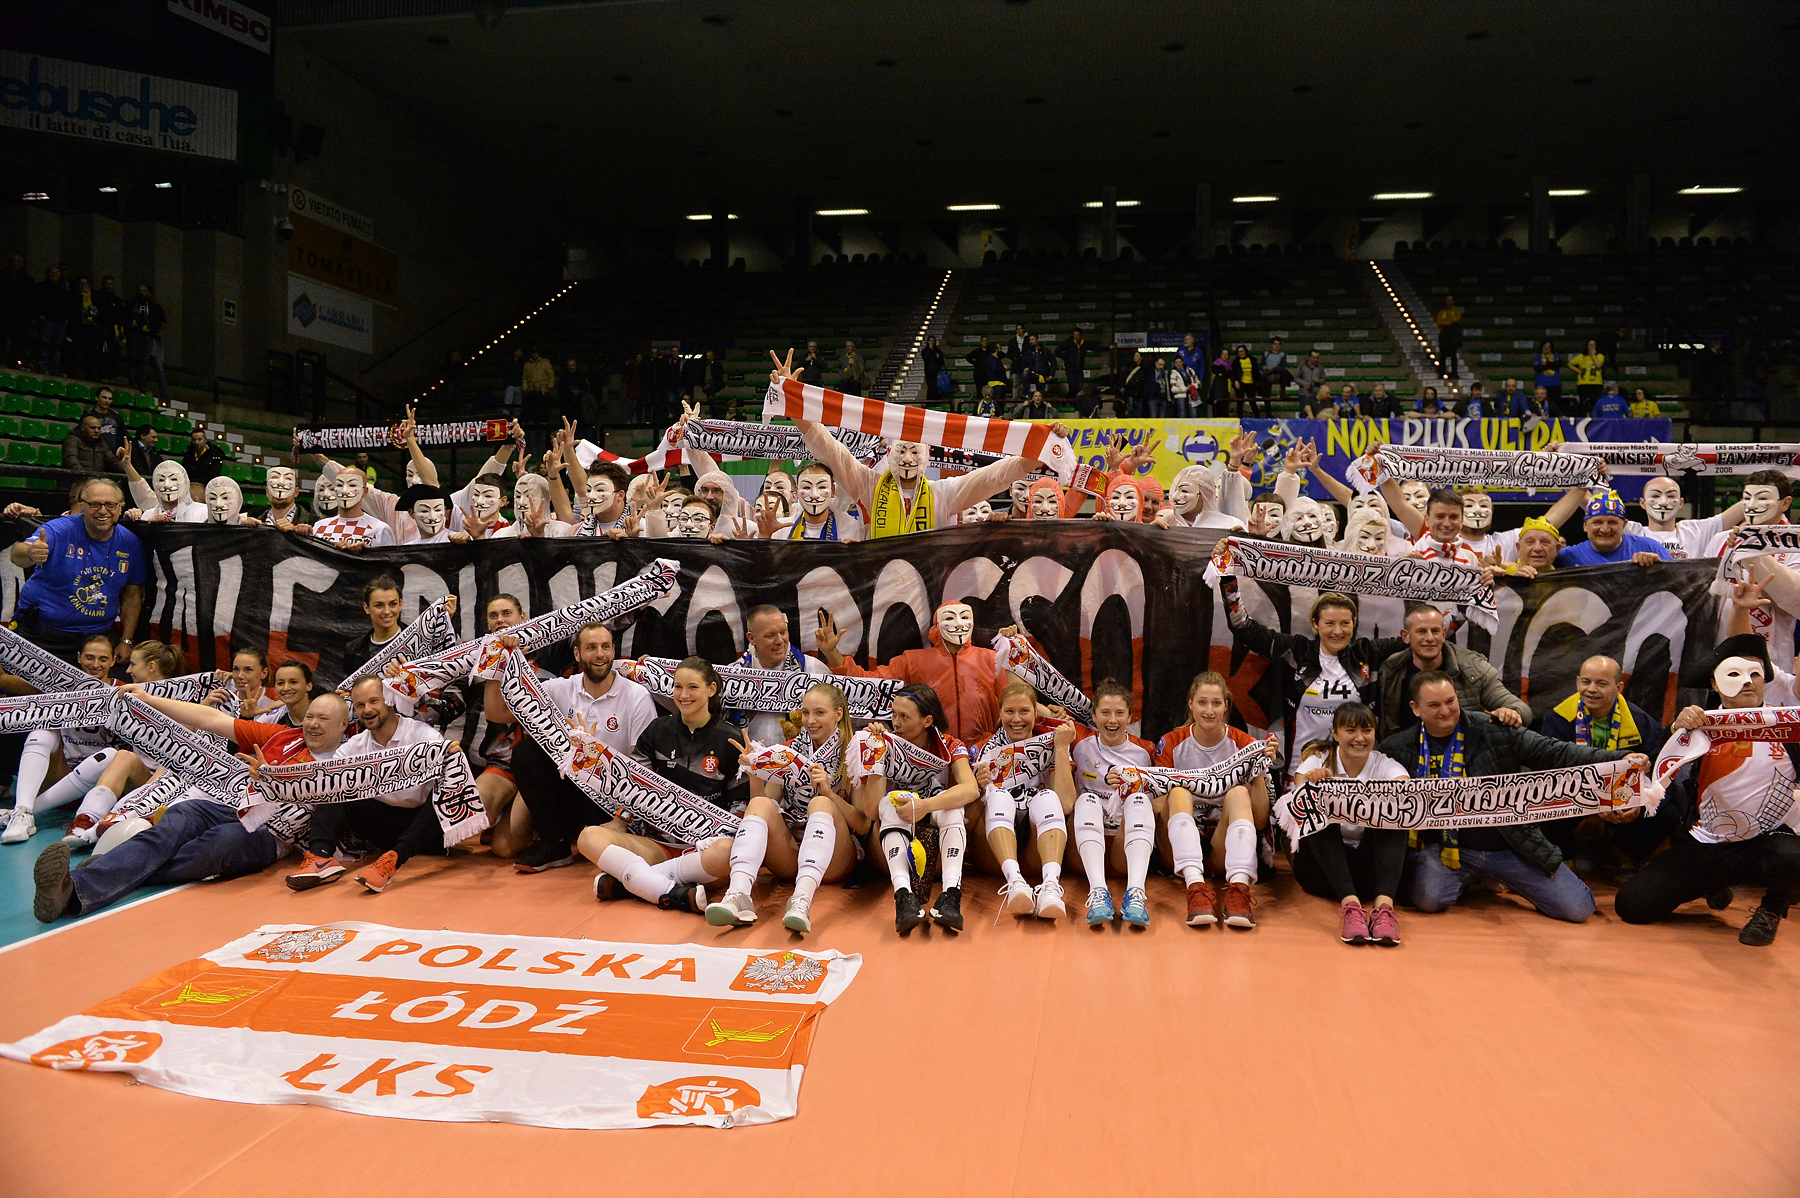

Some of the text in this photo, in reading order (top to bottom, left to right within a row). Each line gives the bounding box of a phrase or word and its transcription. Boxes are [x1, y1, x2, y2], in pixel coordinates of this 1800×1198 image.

[29, 114, 196, 153] il latte di casa Tua.
[308, 198, 341, 222] VIETATO
[296, 247, 393, 296] TOMASELLA
[320, 421, 484, 449] RETKIŃSCY FANATYCY
[1327, 418, 1391, 459] NON
[1513, 452, 1598, 476] Galery
[1252, 541, 1308, 554] NAJWIERNIEJSI
[1310, 549, 1332, 557] KIBICE
[1341, 553, 1367, 561] MIASTA
[1369, 556, 1391, 564] ŁODZI
[1386, 558, 1484, 592] Galery
[21, 641, 39, 655] KIBICE
[45, 654, 67, 669] MIASTA
[67, 667, 85, 678] ŁODZI
[360, 658, 379, 674] KIBICE
[383, 637, 404, 655] MIASTA
[402, 622, 418, 638] ŁODZI
[766, 670, 787, 678] ŁODZI
[1323, 679, 1351, 699] 14
[36, 693, 57, 701] KIBICE
[64, 691, 89, 699] MIASTA
[91, 688, 111, 696] ŁODZI
[521, 661, 555, 708] NAJWIERNIEJSI
[554, 708, 568, 727] KIBICE
[124, 693, 171, 726] NAJWIERNIEJSI
[172, 724, 193, 739] KIBICE
[197, 739, 221, 759] MIASTA
[221, 754, 241, 769] ŁODZI
[1705, 711, 1765, 726] DZKI
[1744, 727, 1792, 740] LAT
[114, 711, 206, 769] anatycy
[1237, 743, 1262, 761] MIASTA
[263, 763, 321, 774] NAJWIERNIEJSI
[321, 760, 346, 768] KIBICE
[355, 752, 383, 762] MIASTA
[384, 748, 406, 758] ŁODZI
[627, 761, 676, 795] NAJWIERNIEJSI
[677, 790, 699, 805] KIBICE
[705, 804, 731, 821] MIASTA
[1322, 792, 1427, 828] Galery
[1452, 818, 1483, 826] MIASTA
[1493, 815, 1518, 824] KIBICE
[1522, 808, 1584, 821] NAJWIERNIEJSI
[358, 939, 697, 982] POLSKA
[332, 989, 608, 1035] ŁÓDŹ
[281, 1053, 494, 1097] ŁKS
